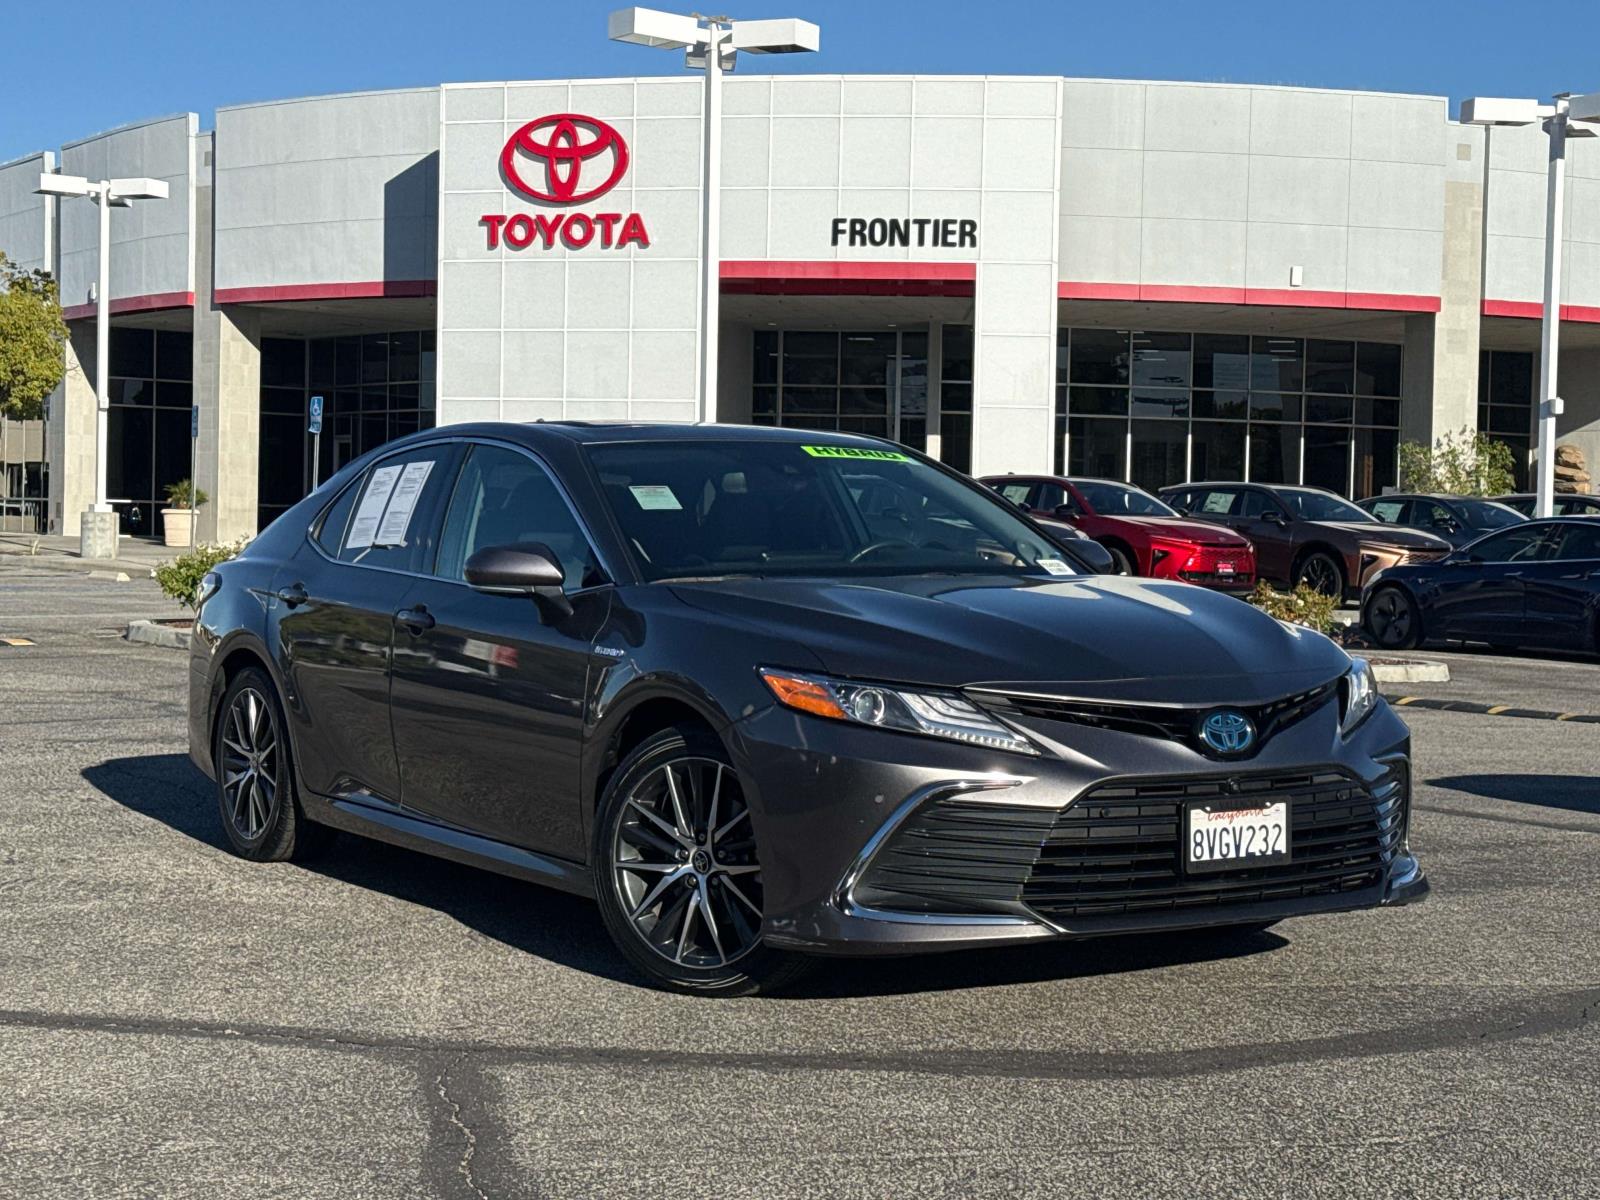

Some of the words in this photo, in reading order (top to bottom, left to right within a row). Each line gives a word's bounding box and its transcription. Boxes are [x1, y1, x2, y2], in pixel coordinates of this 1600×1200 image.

[481, 212, 650, 248] TOYOTA
[831, 218, 978, 248] FRONTIER
[812, 447, 901, 460] HYBRID
[1193, 823, 1283, 860] 8VGV232
